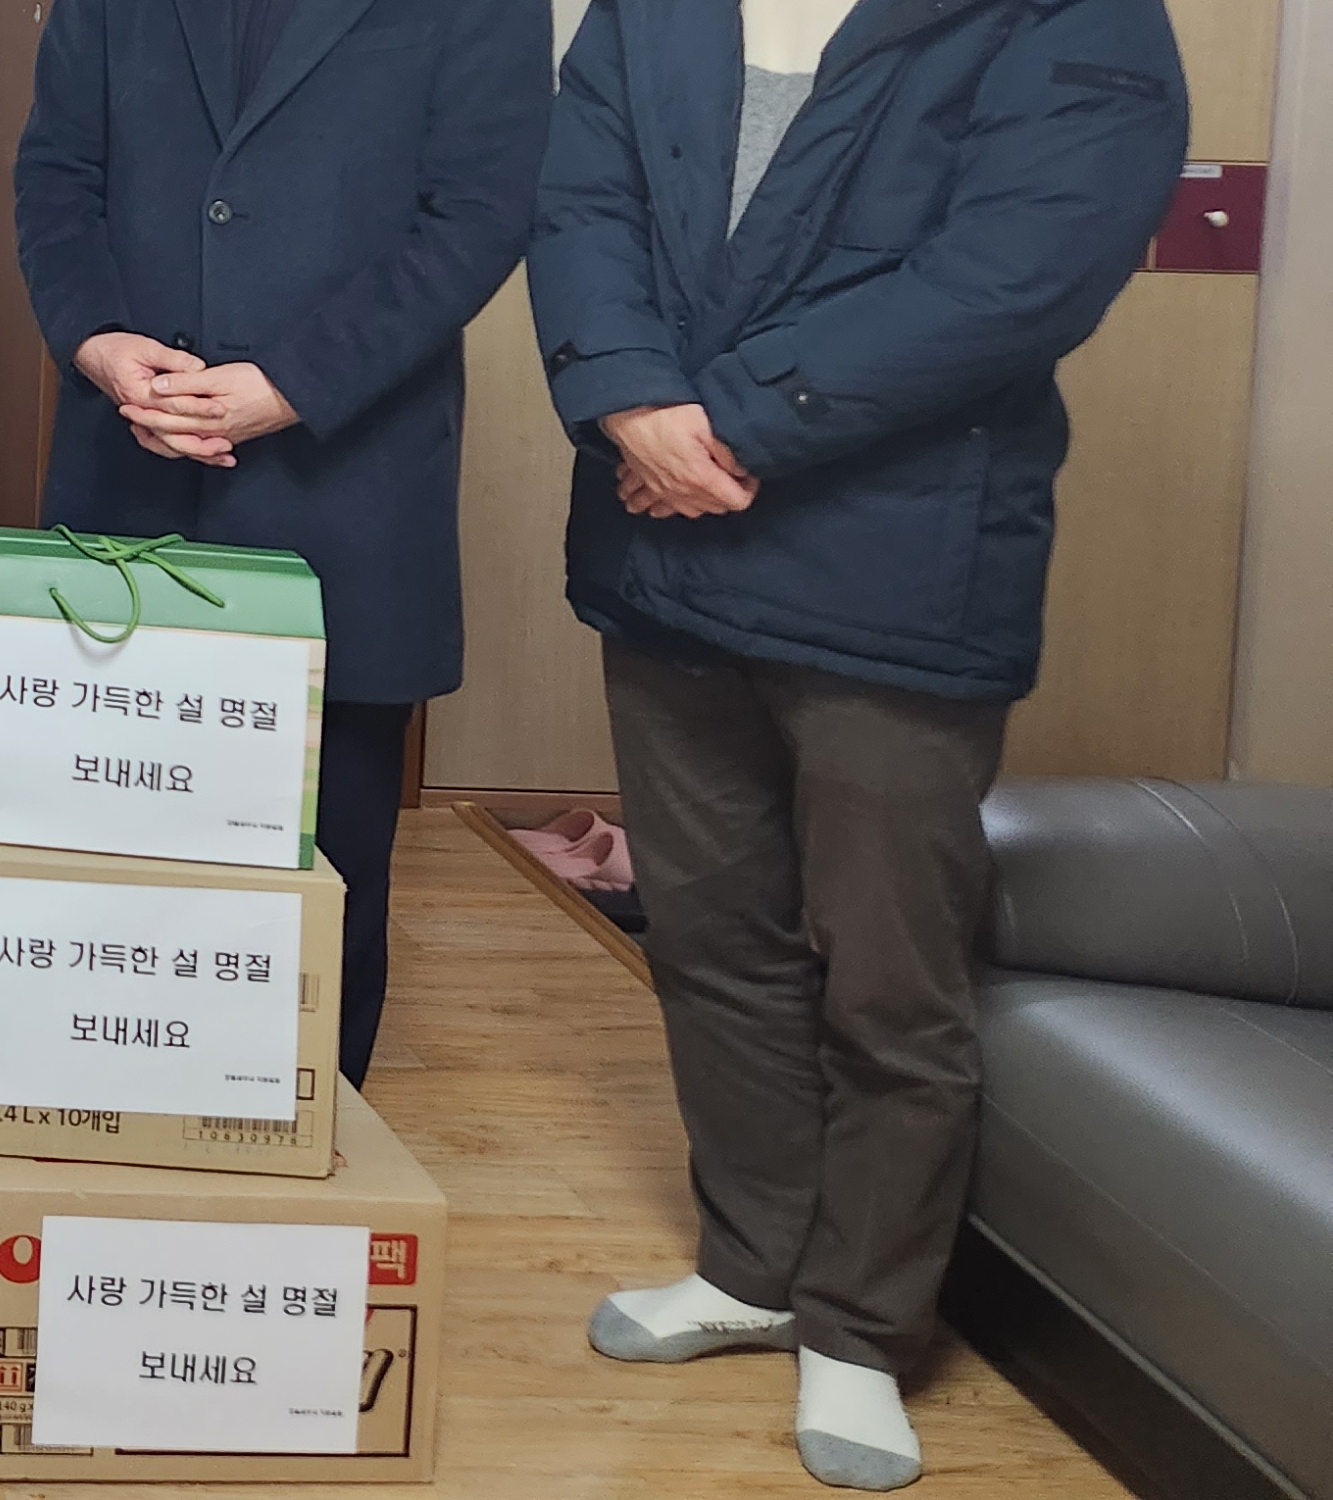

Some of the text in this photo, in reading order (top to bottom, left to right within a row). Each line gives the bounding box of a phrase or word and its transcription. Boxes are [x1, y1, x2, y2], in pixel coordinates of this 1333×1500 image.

[71, 681, 164, 720] 가득한
[175, 693, 204, 725] 설
[220, 697, 278, 732] 명절
[71, 754, 194, 794] 보내세요
[69, 941, 160, 976] 가득한
[172, 948, 198, 979] 설
[214, 951, 271, 984] 명절
[70, 1013, 191, 1049] 보내세요
[59, 1108, 121, 1134] 10개입
[66, 1274, 338, 1318] 사랑 가득한 설 명절
[138, 1350, 257, 1385] 보내세요
